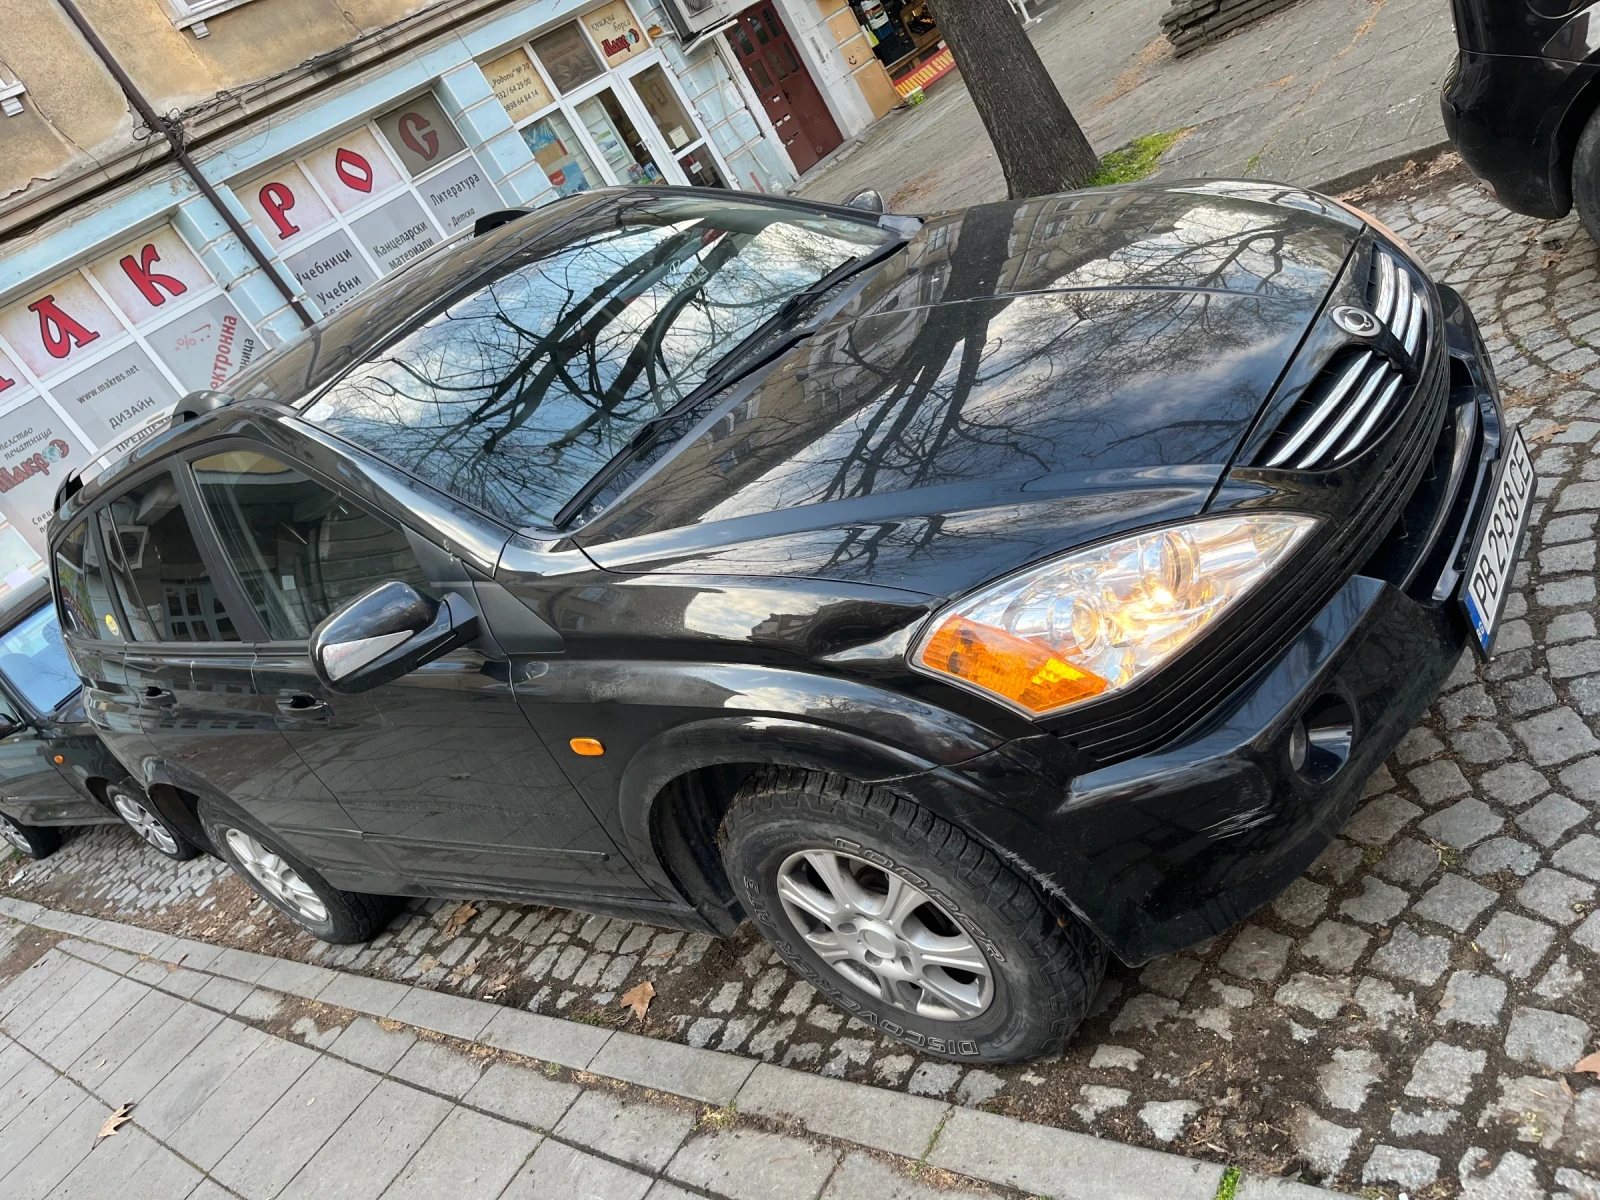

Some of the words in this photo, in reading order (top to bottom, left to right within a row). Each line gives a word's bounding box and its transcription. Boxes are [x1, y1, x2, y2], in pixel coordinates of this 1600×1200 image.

[521, 62, 531, 72] 70
[509, 85, 517, 94] 64
[516, 81, 524, 90] 29
[523, 77, 532, 87] 00
[516, 96, 525, 106] 64
[523, 92, 532, 102] 84
[530, 89, 539, 98] 14
[430, 173, 480, 206] Литература
[452, 207, 476, 228] Детска
[372, 221, 428, 258] Канцеларски
[388, 237, 435, 271] материали
[294, 248, 352, 286] Учебници
[317, 275, 362, 306] Учебни
[77, 364, 140, 404] www.makros.net
[108, 396, 156, 431] ДИЗАЙН
[4, 428, 53, 461] печатница
[1488, 481, 1519, 577] 2938
[1476, 620, 1485, 643] BG
[835, 837, 1005, 963] COOPER
[775, 940, 980, 1056] DISCOVERER
